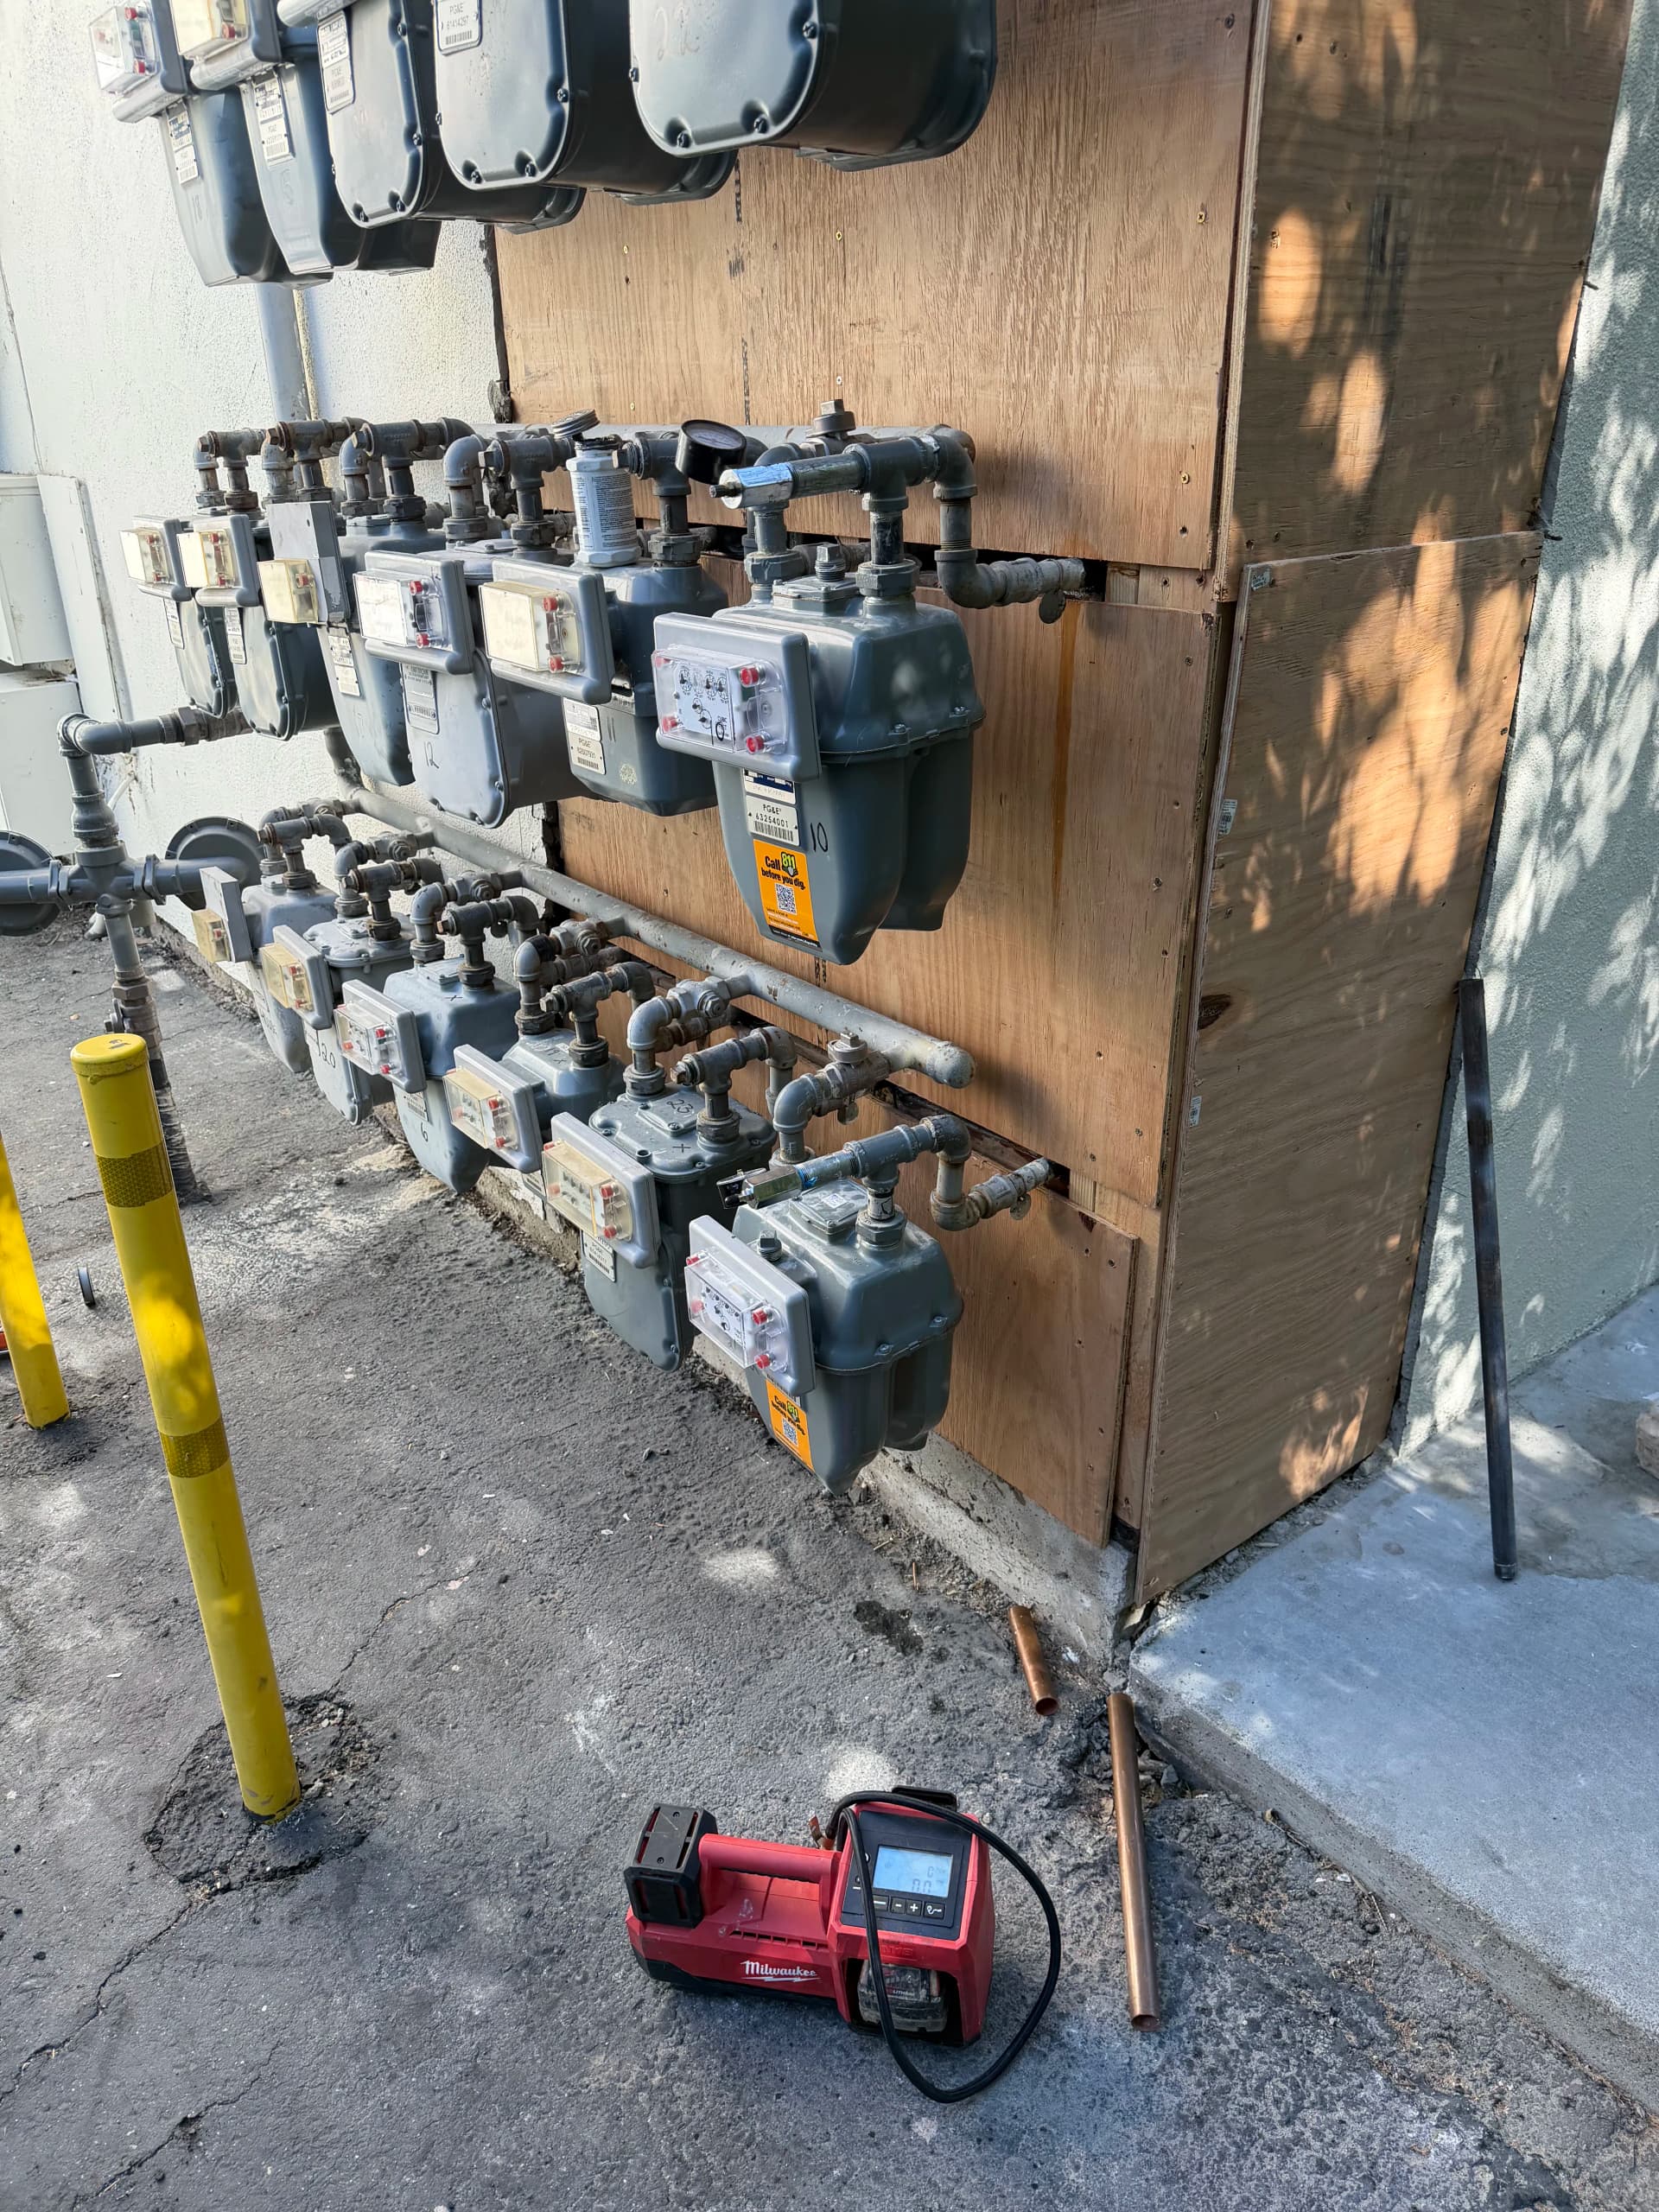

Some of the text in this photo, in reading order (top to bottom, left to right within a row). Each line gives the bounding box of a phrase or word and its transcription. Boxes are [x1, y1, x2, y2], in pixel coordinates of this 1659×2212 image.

[763, 804, 779, 815] PG&E
[755, 813, 789, 829] 63254001
[810, 822, 829, 853] 10
[765, 853, 796, 871] Call 811
[761, 867, 782, 881] before
[782, 875, 794, 885] you
[665, 1098, 694, 1114] 23
[740, 1960, 817, 1977] Milwaukee
